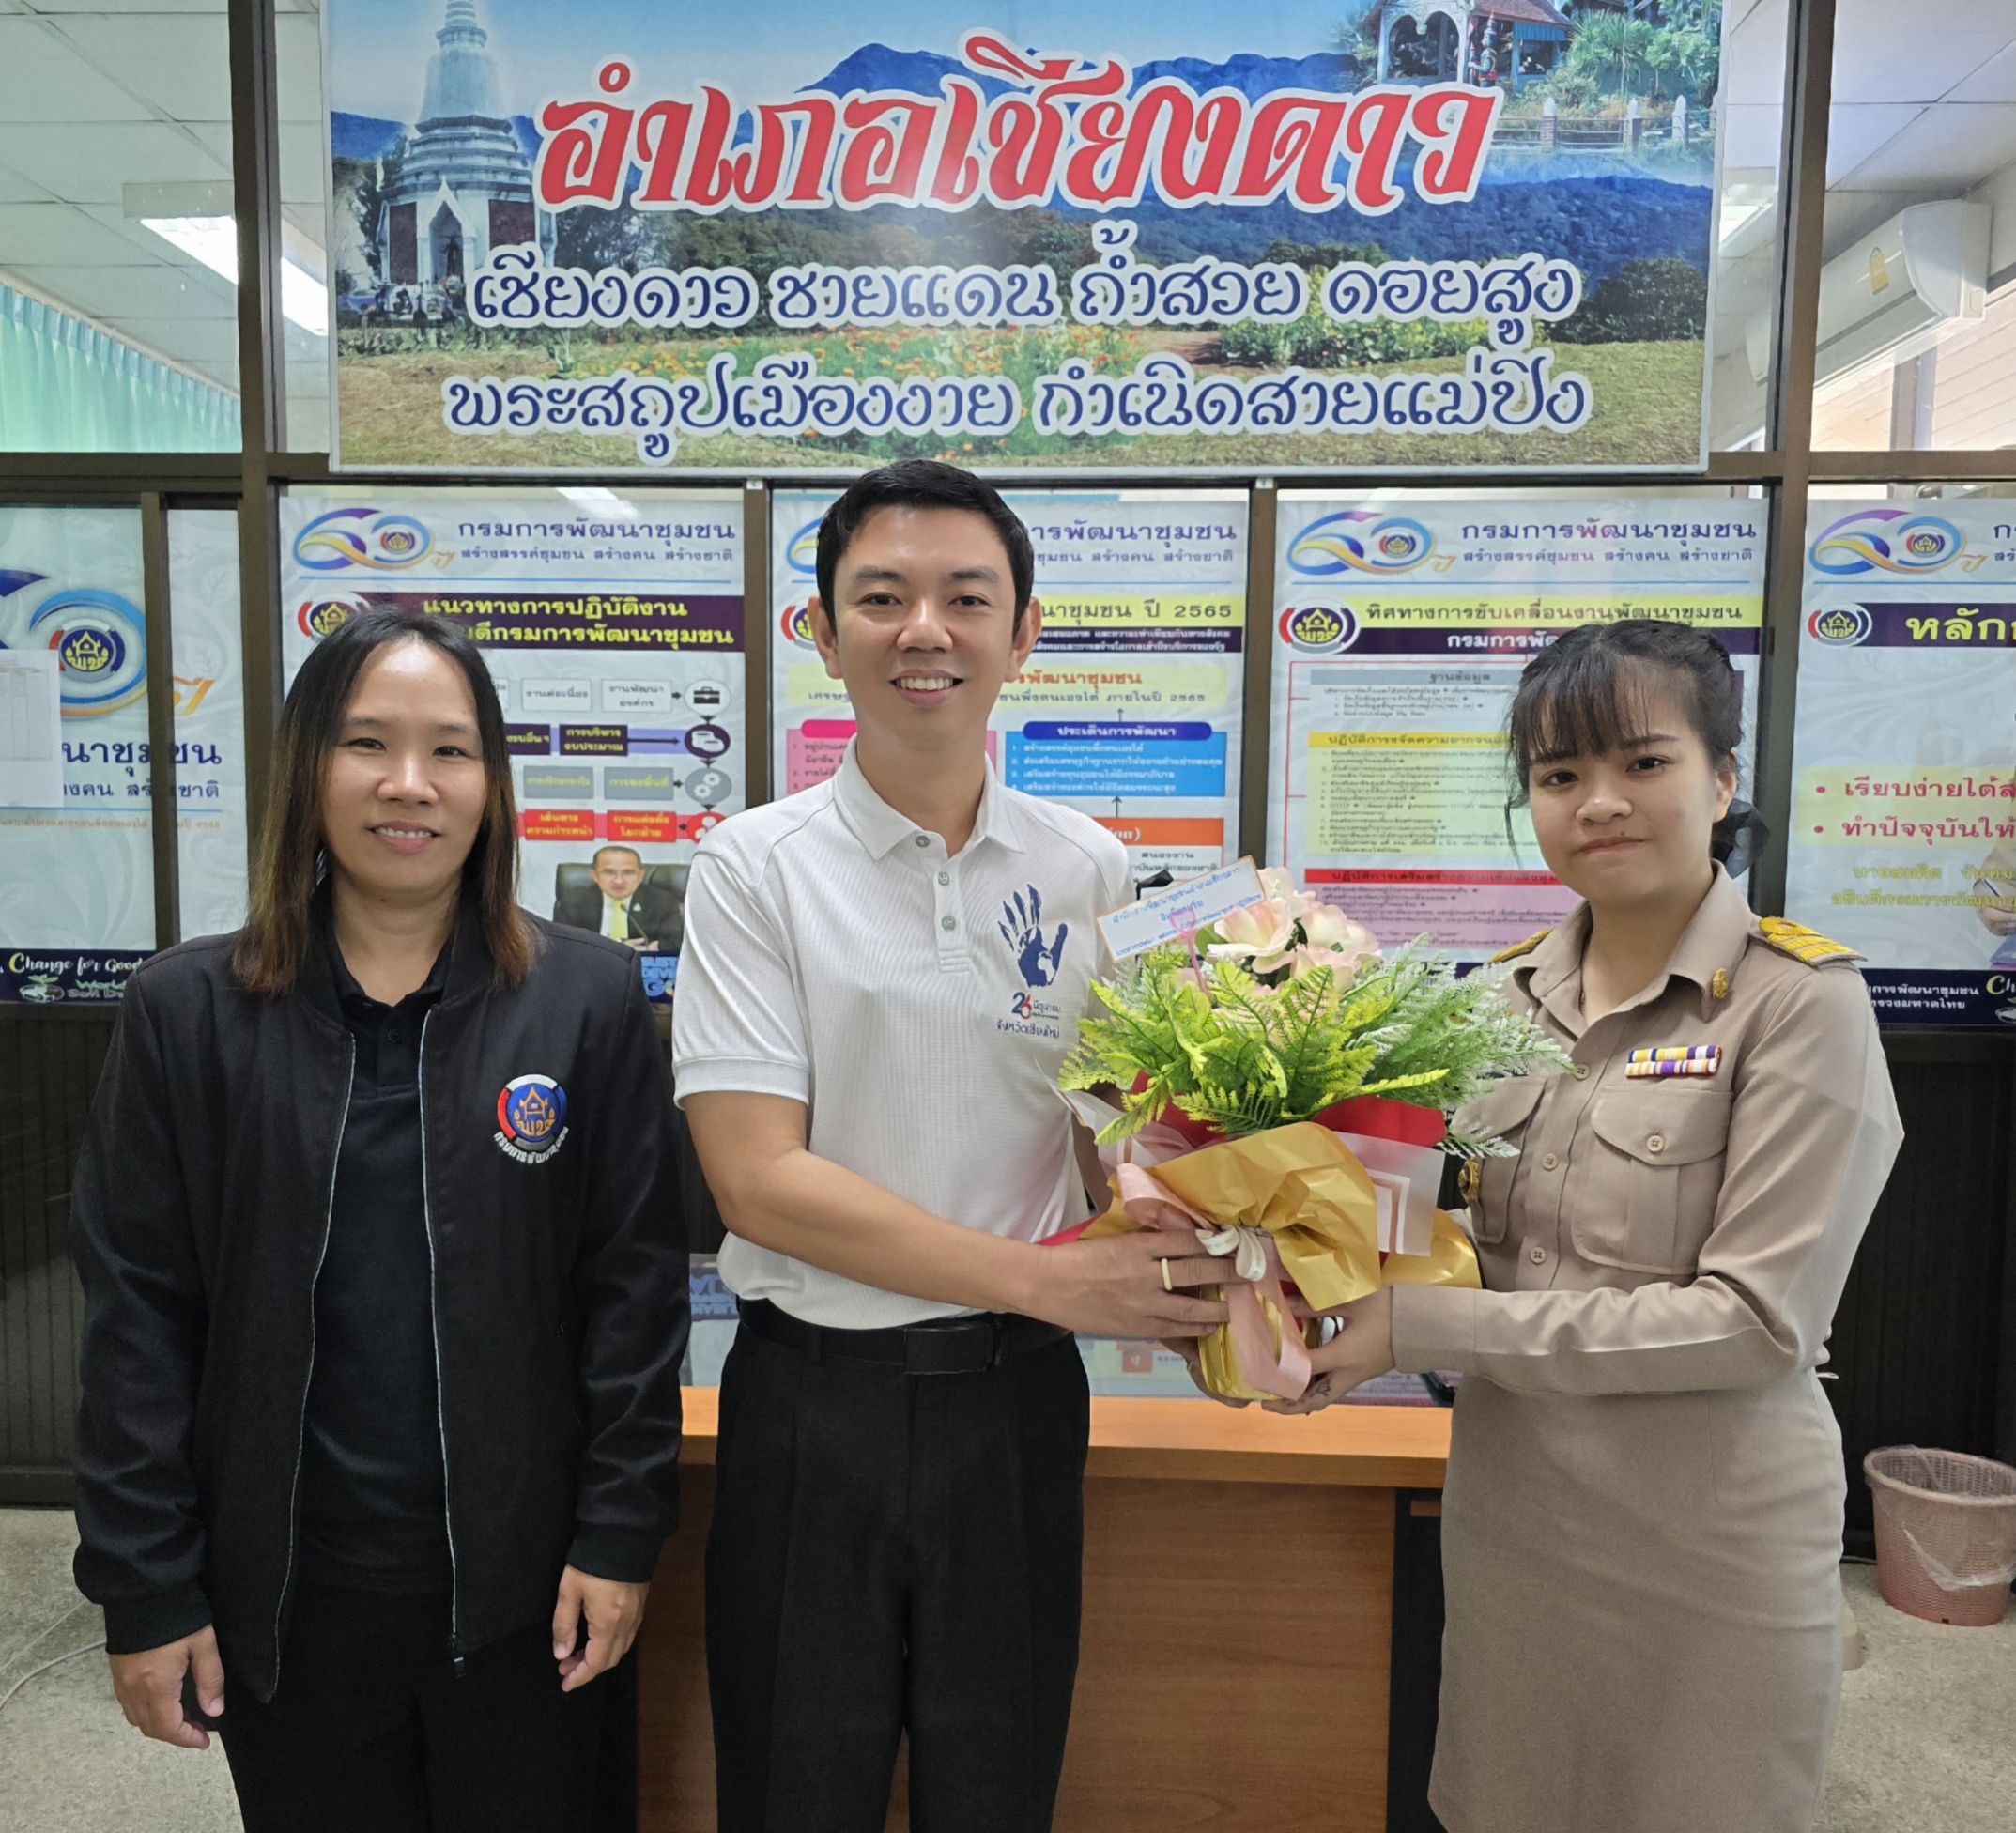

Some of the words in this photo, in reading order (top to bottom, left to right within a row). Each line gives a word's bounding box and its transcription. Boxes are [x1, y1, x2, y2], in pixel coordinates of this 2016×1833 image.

[541, 36, 1496, 208] อำเภอเชียงดาว
[473, 251, 750, 319] เชียงดาว
[777, 270, 1055, 319] ชายแดน
[1079, 226, 1301, 316] ถ้ำสวย
[1329, 260, 1574, 345] ดอยสูง
[449, 360, 1013, 457] พระสถูปเมืองงาย
[1039, 354, 1586, 426] กำเนิดสายแม่ปิง
[458, 517, 736, 546] กรมการพัฒนาชุมชน
[1030, 519, 1238, 548] ารพัฒนาชุมชน
[1462, 518, 1757, 546] กรมการพัฒนาชุมชน
[460, 546, 585, 562] สร้างสรรค์ชุมชน
[593, 547, 656, 561] สร้างคน
[665, 548, 733, 562] สร้างชาติ
[1036, 552, 1083, 566] ชุมชน
[1092, 549, 1155, 562] สร้างคน
[1163, 549, 1234, 562] สร้างชาติ
[1463, 548, 1595, 565] สร้างสรรค์ชุมชน
[1604, 548, 1670, 562] สร้างคน
[1679, 548, 1753, 562] สร้างชาติ
[423, 595, 688, 620] แนวทางการปฏิบัติงาน
[1143, 598, 1161, 618] ปี
[1174, 605, 1232, 618] 2565
[1365, 598, 1743, 624] ทิศทางการขับเคลื่อนงานพัฒนาชุมชน
[467, 620, 735, 651] ดีกรมการพัฒนาชุมชน
[1905, 607, 2016, 641] หลัก
[1057, 722, 1177, 736] ประเด็นการพัฒนา
[1844, 776, 2016, 799] เรียบง่ายได้ส
[1841, 815, 2016, 846] ทำปัจจุบันให้
[8, 952, 73, 974] Change
[1868, 983, 1979, 999] การพัฒนาชุมชน
[1012, 992, 1032, 1020] 26
